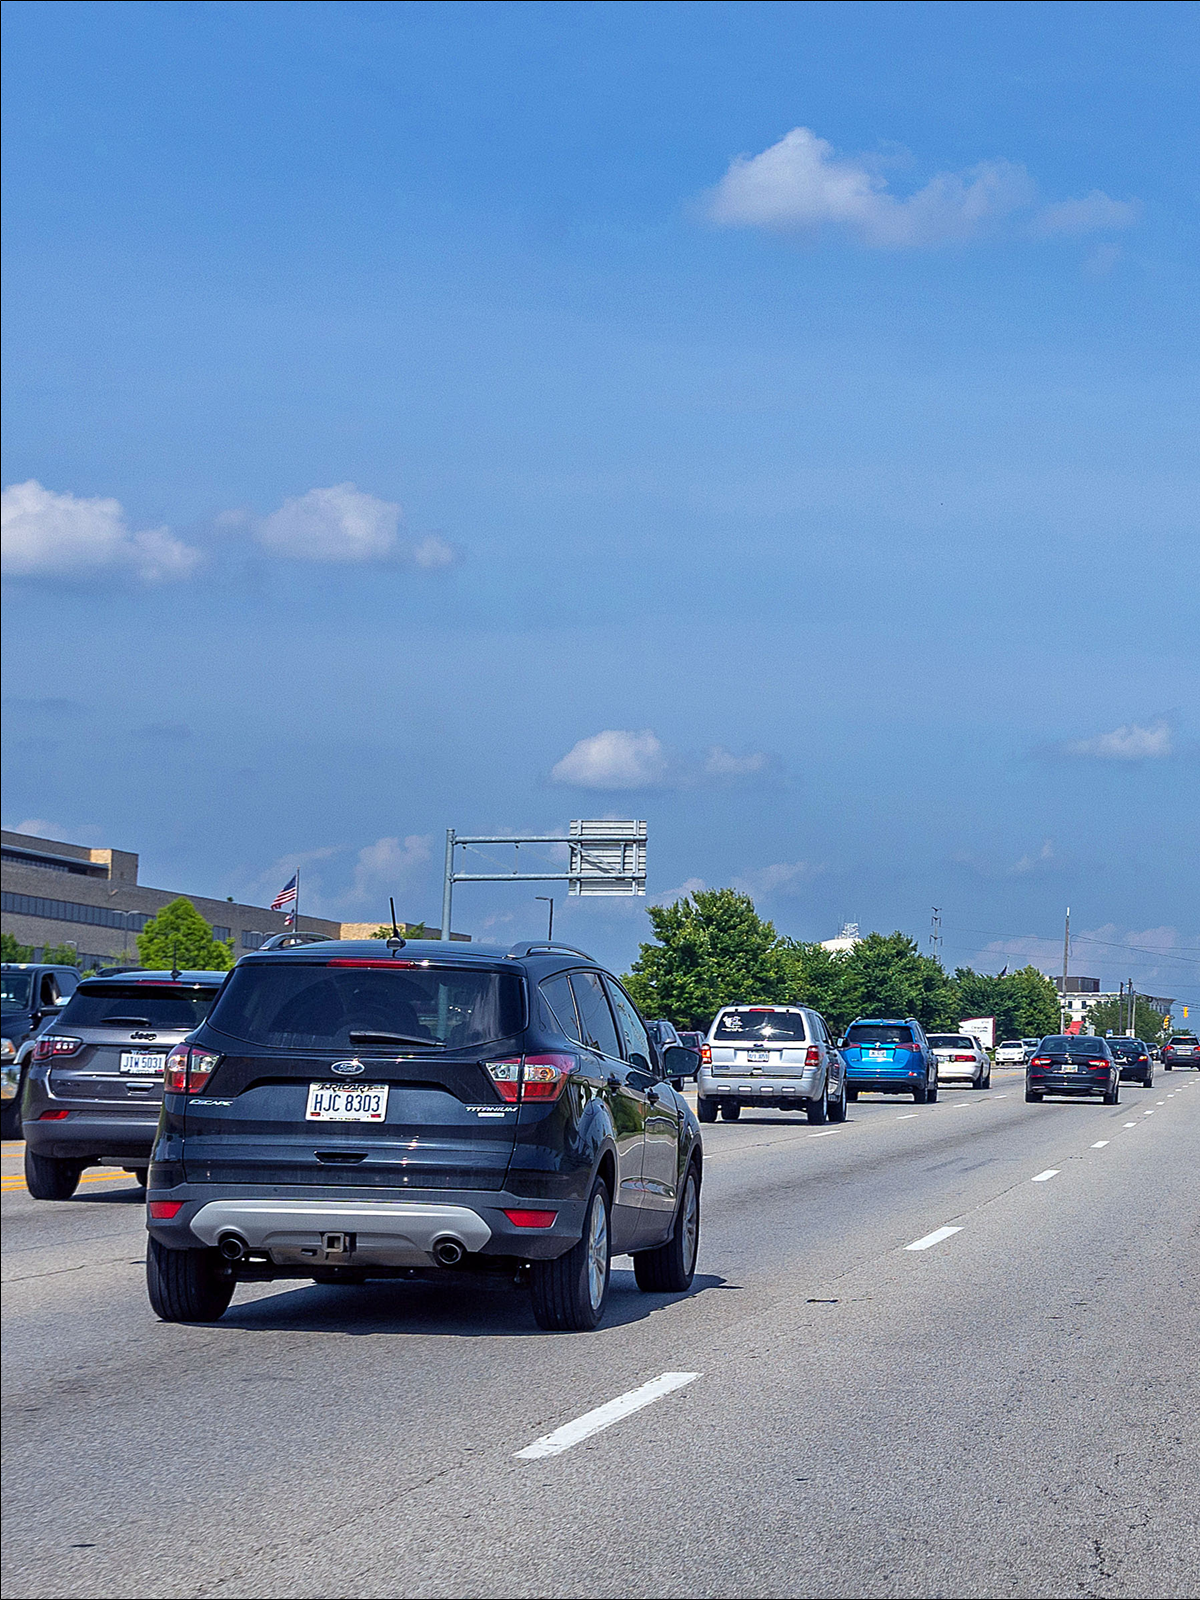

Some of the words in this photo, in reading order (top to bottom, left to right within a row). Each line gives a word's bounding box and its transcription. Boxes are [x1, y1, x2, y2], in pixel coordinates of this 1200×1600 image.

[130, 1031, 157, 1041] Jeep
[141, 1057, 162, 1069] 5031
[338, 1063, 358, 1072] Ford
[188, 1098, 234, 1106] ESCAPE
[313, 1093, 341, 1112] HJC
[344, 1094, 381, 1112] 8303
